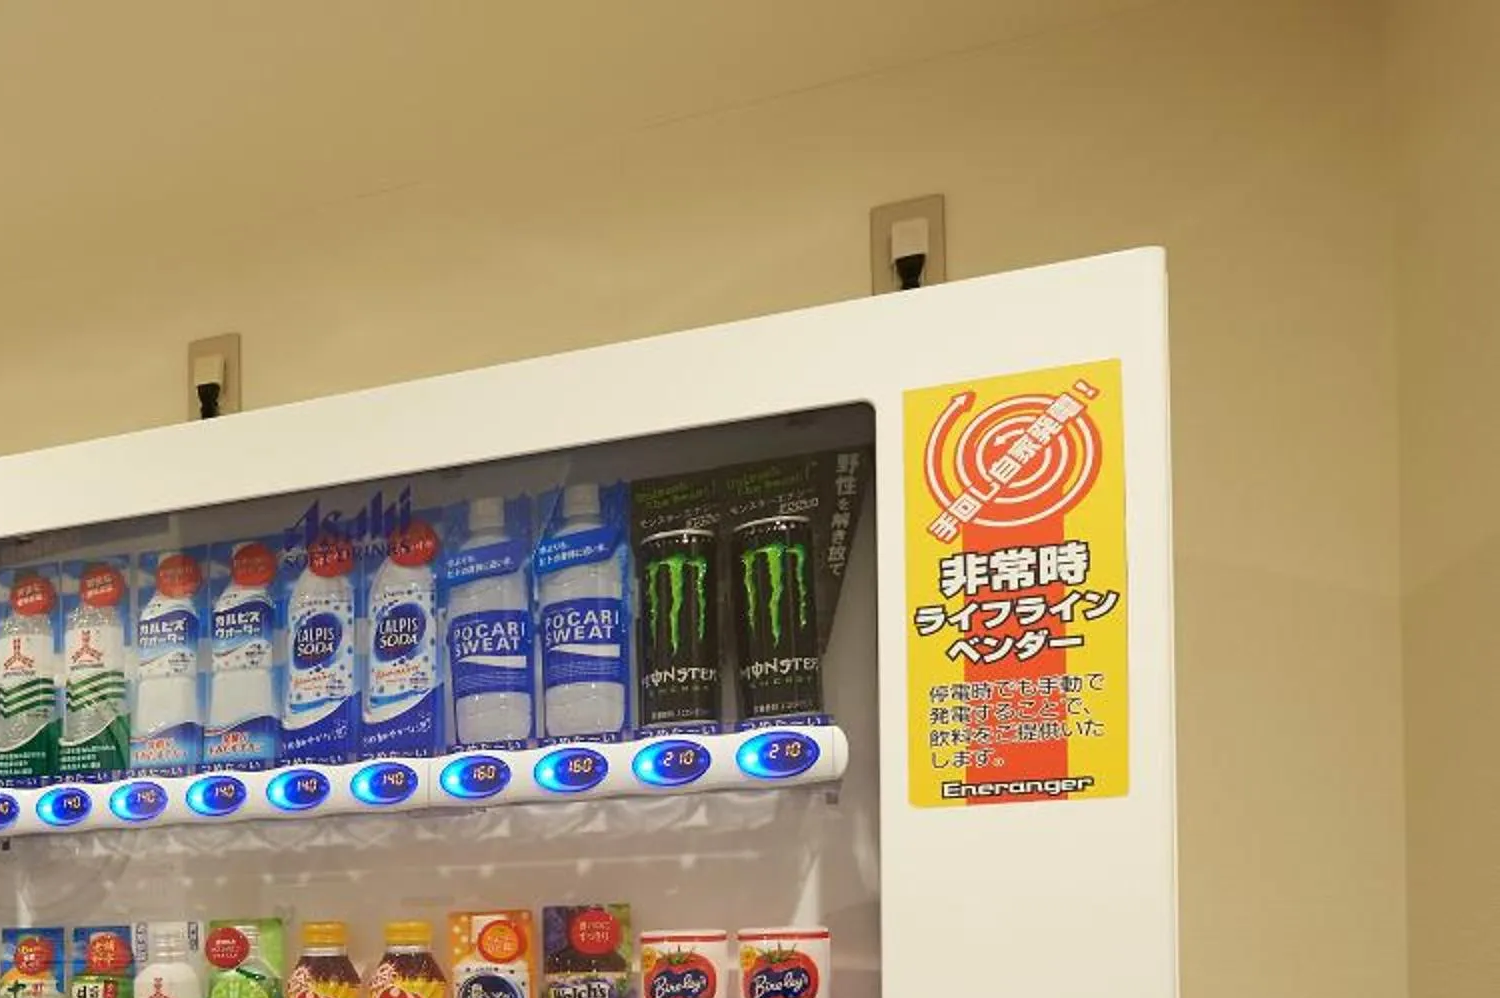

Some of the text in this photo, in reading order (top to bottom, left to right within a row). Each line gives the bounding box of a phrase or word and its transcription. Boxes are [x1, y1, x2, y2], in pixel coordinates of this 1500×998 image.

[940, 541, 1089, 597] 非常時
[546, 609, 619, 629] POCARI
[914, 590, 1119, 635] ライフライン
[380, 634, 417, 648] SODA
[454, 622, 525, 641] POCARI
[546, 625, 613, 646] SWEAT
[297, 642, 333, 656] SODA
[455, 637, 520, 657] SWEAT
[947, 631, 1084, 664] ベンダー
[929, 673, 1105, 704] 停電時でも手動で
[929, 697, 1092, 726] 発電することで、
[929, 719, 1105, 749] 飲料をご提供いた
[663, 750, 695, 766] 210
[769, 742, 800, 759] 210
[932, 747, 1006, 769] します。
[473, 765, 496, 781] 160
[567, 758, 593, 774] 160
[297, 779, 316, 792] 140
[383, 772, 404, 785] 140
[942, 775, 1094, 798] Eneranger
